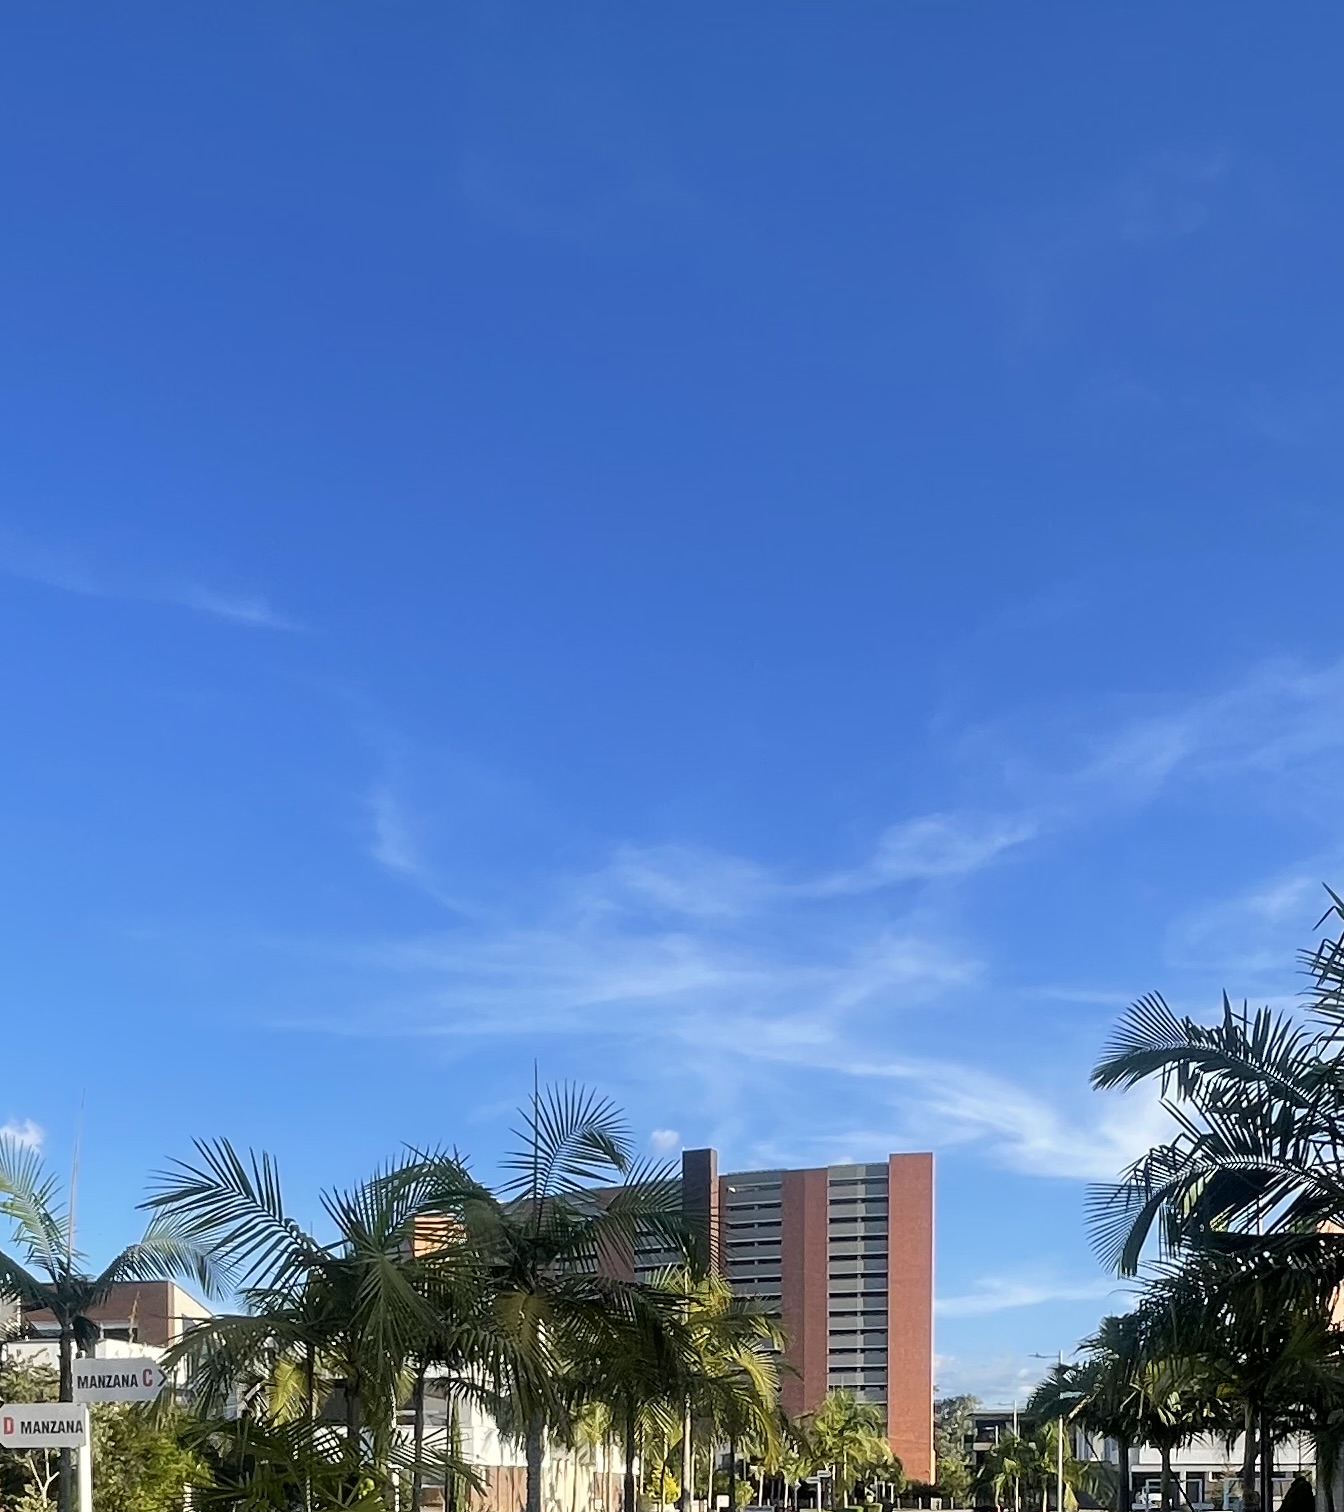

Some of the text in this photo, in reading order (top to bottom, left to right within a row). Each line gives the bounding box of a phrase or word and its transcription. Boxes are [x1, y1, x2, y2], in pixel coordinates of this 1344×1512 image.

[77, 1368, 153, 1389] MANZANA C
[3, 1416, 84, 1435] D MANZANA
